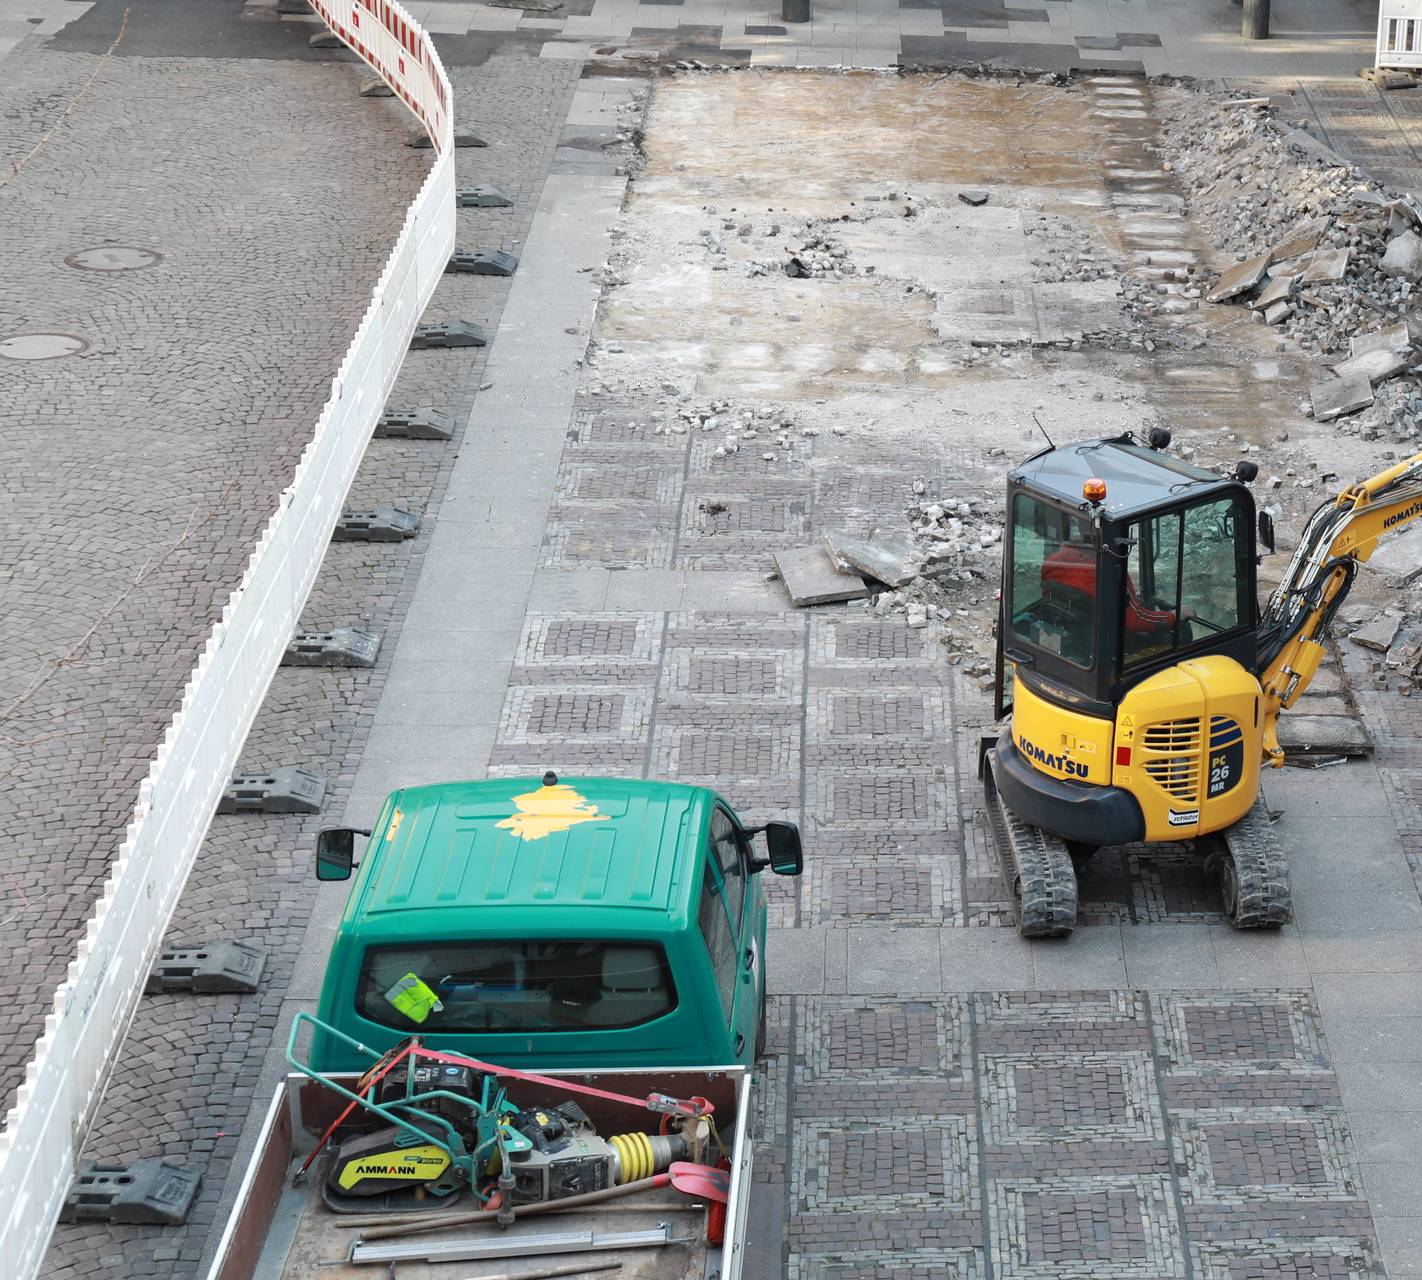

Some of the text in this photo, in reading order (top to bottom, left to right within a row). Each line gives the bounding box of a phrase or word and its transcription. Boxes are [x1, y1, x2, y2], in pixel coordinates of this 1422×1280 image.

[1019, 734, 1089, 778] KOMATSU
[1212, 755, 1226, 768] PC
[1211, 765, 1230, 783] 26
[1210, 782, 1225, 793] MR
[356, 1165, 416, 1175] AMMANN
